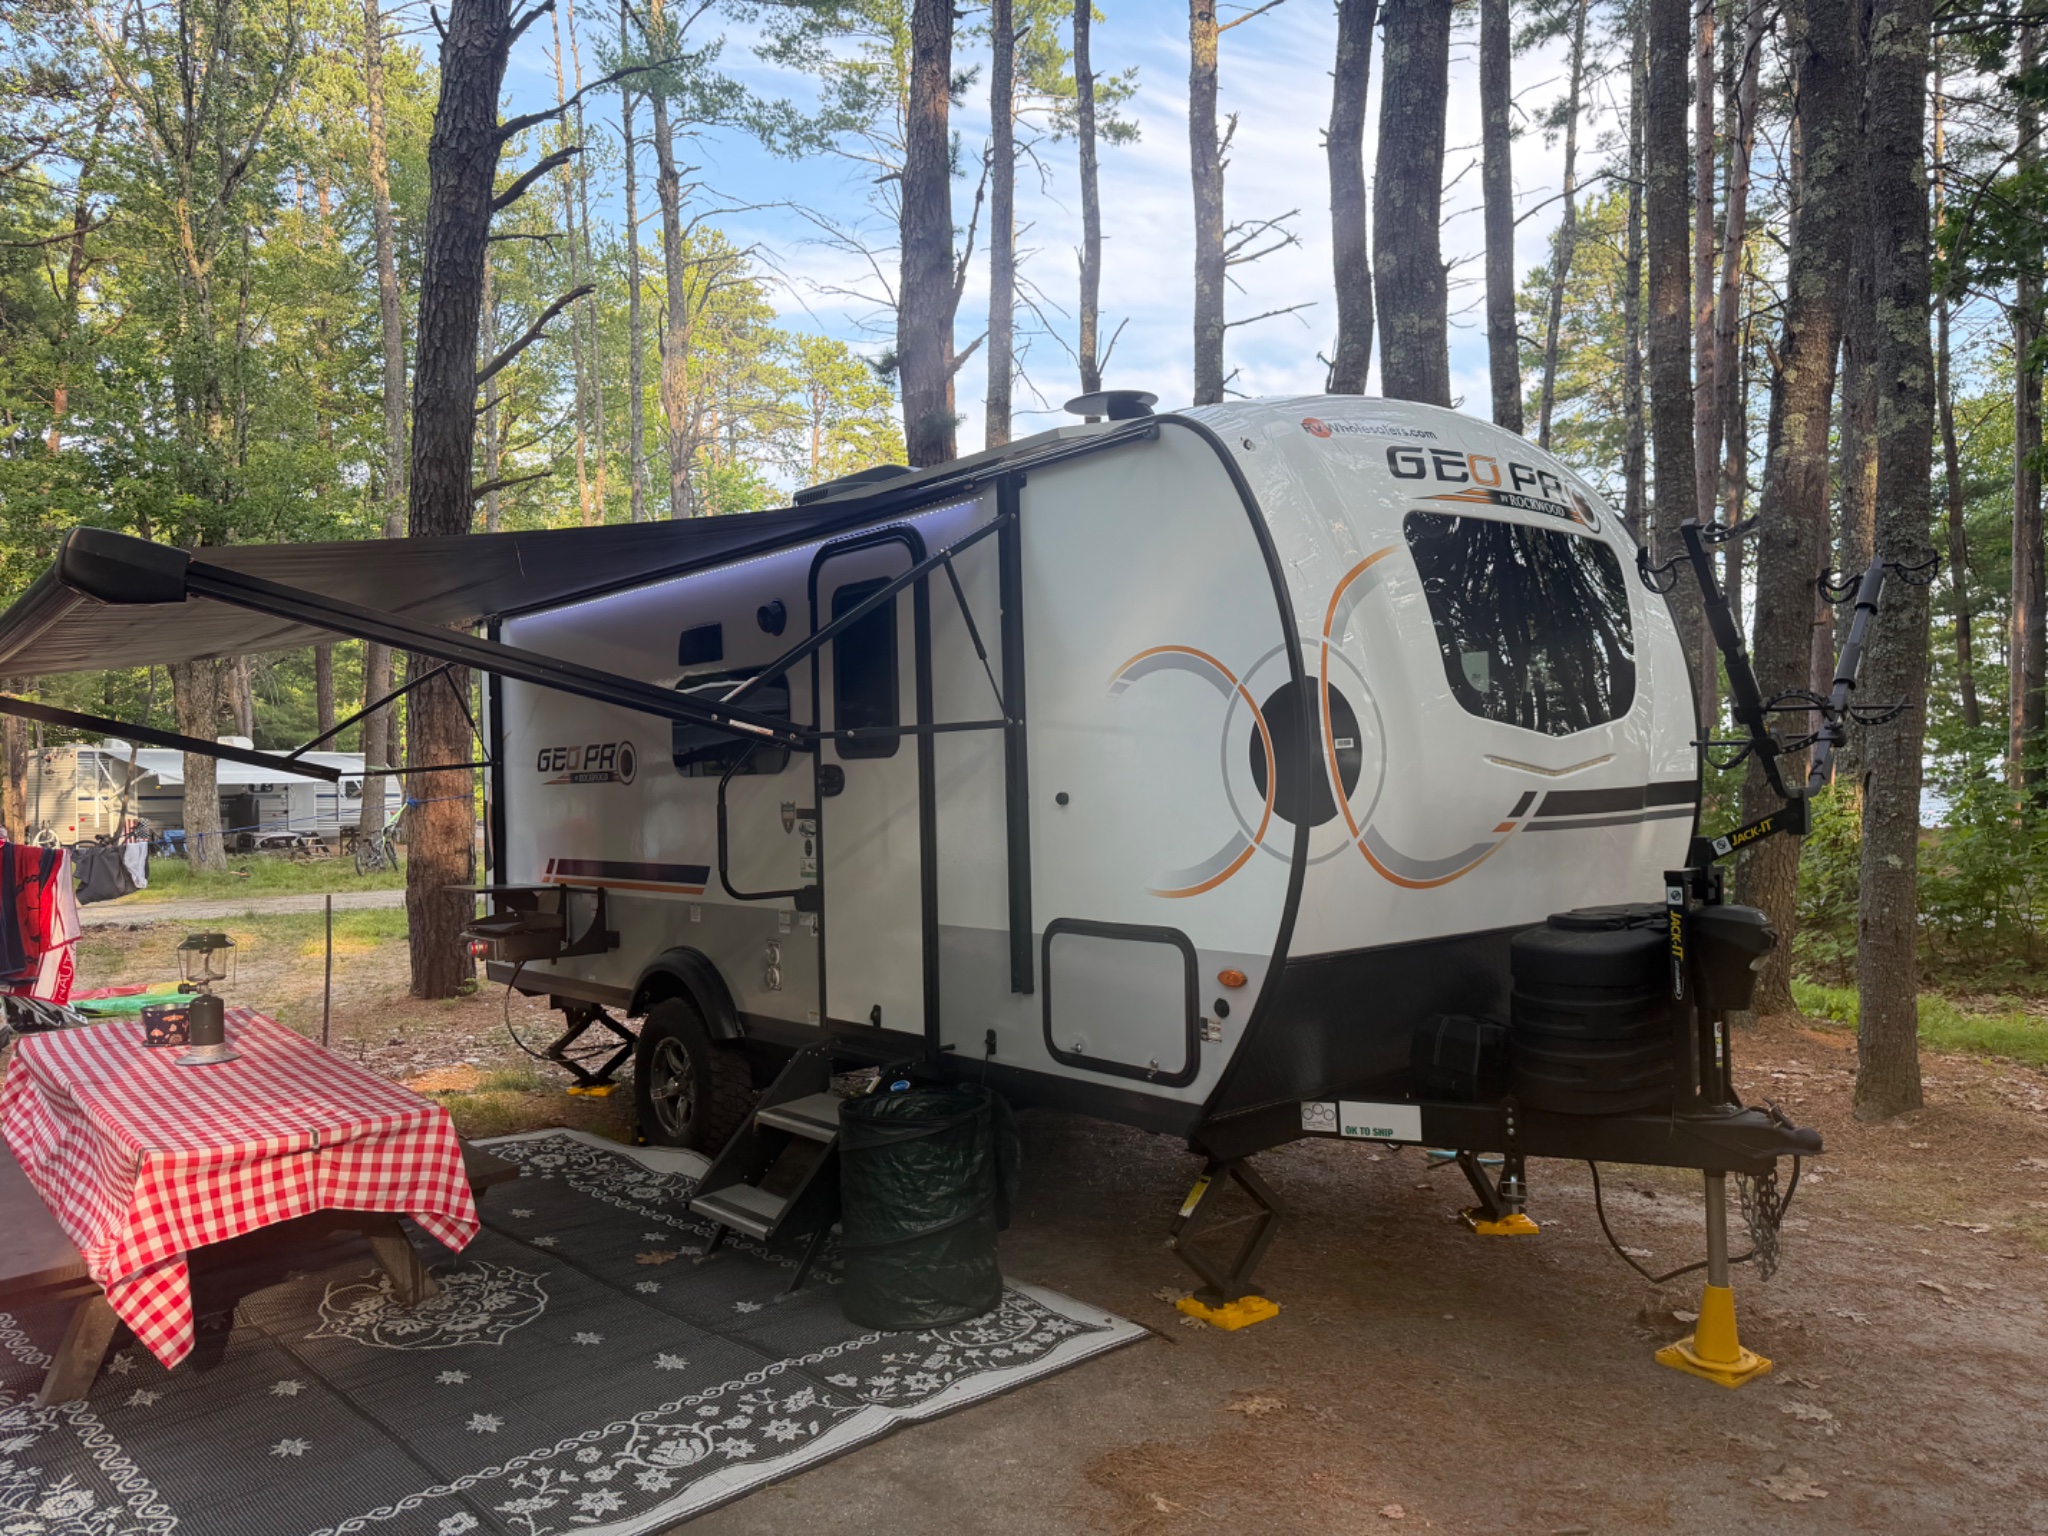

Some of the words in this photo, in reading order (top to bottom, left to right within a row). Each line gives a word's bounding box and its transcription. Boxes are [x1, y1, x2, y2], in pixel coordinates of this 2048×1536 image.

[1386, 446, 1501, 487] GEO
[1508, 494, 1566, 517] ROCKWOOD
[537, 746, 582, 772] GEO
[1732, 819, 1773, 847] JACK-IT
[1670, 910, 1684, 961] JACK-IT
[1345, 1125, 1358, 1135] OK
[1360, 1126, 1371, 1136] TO
[1372, 1128, 1394, 1138] SHIP
